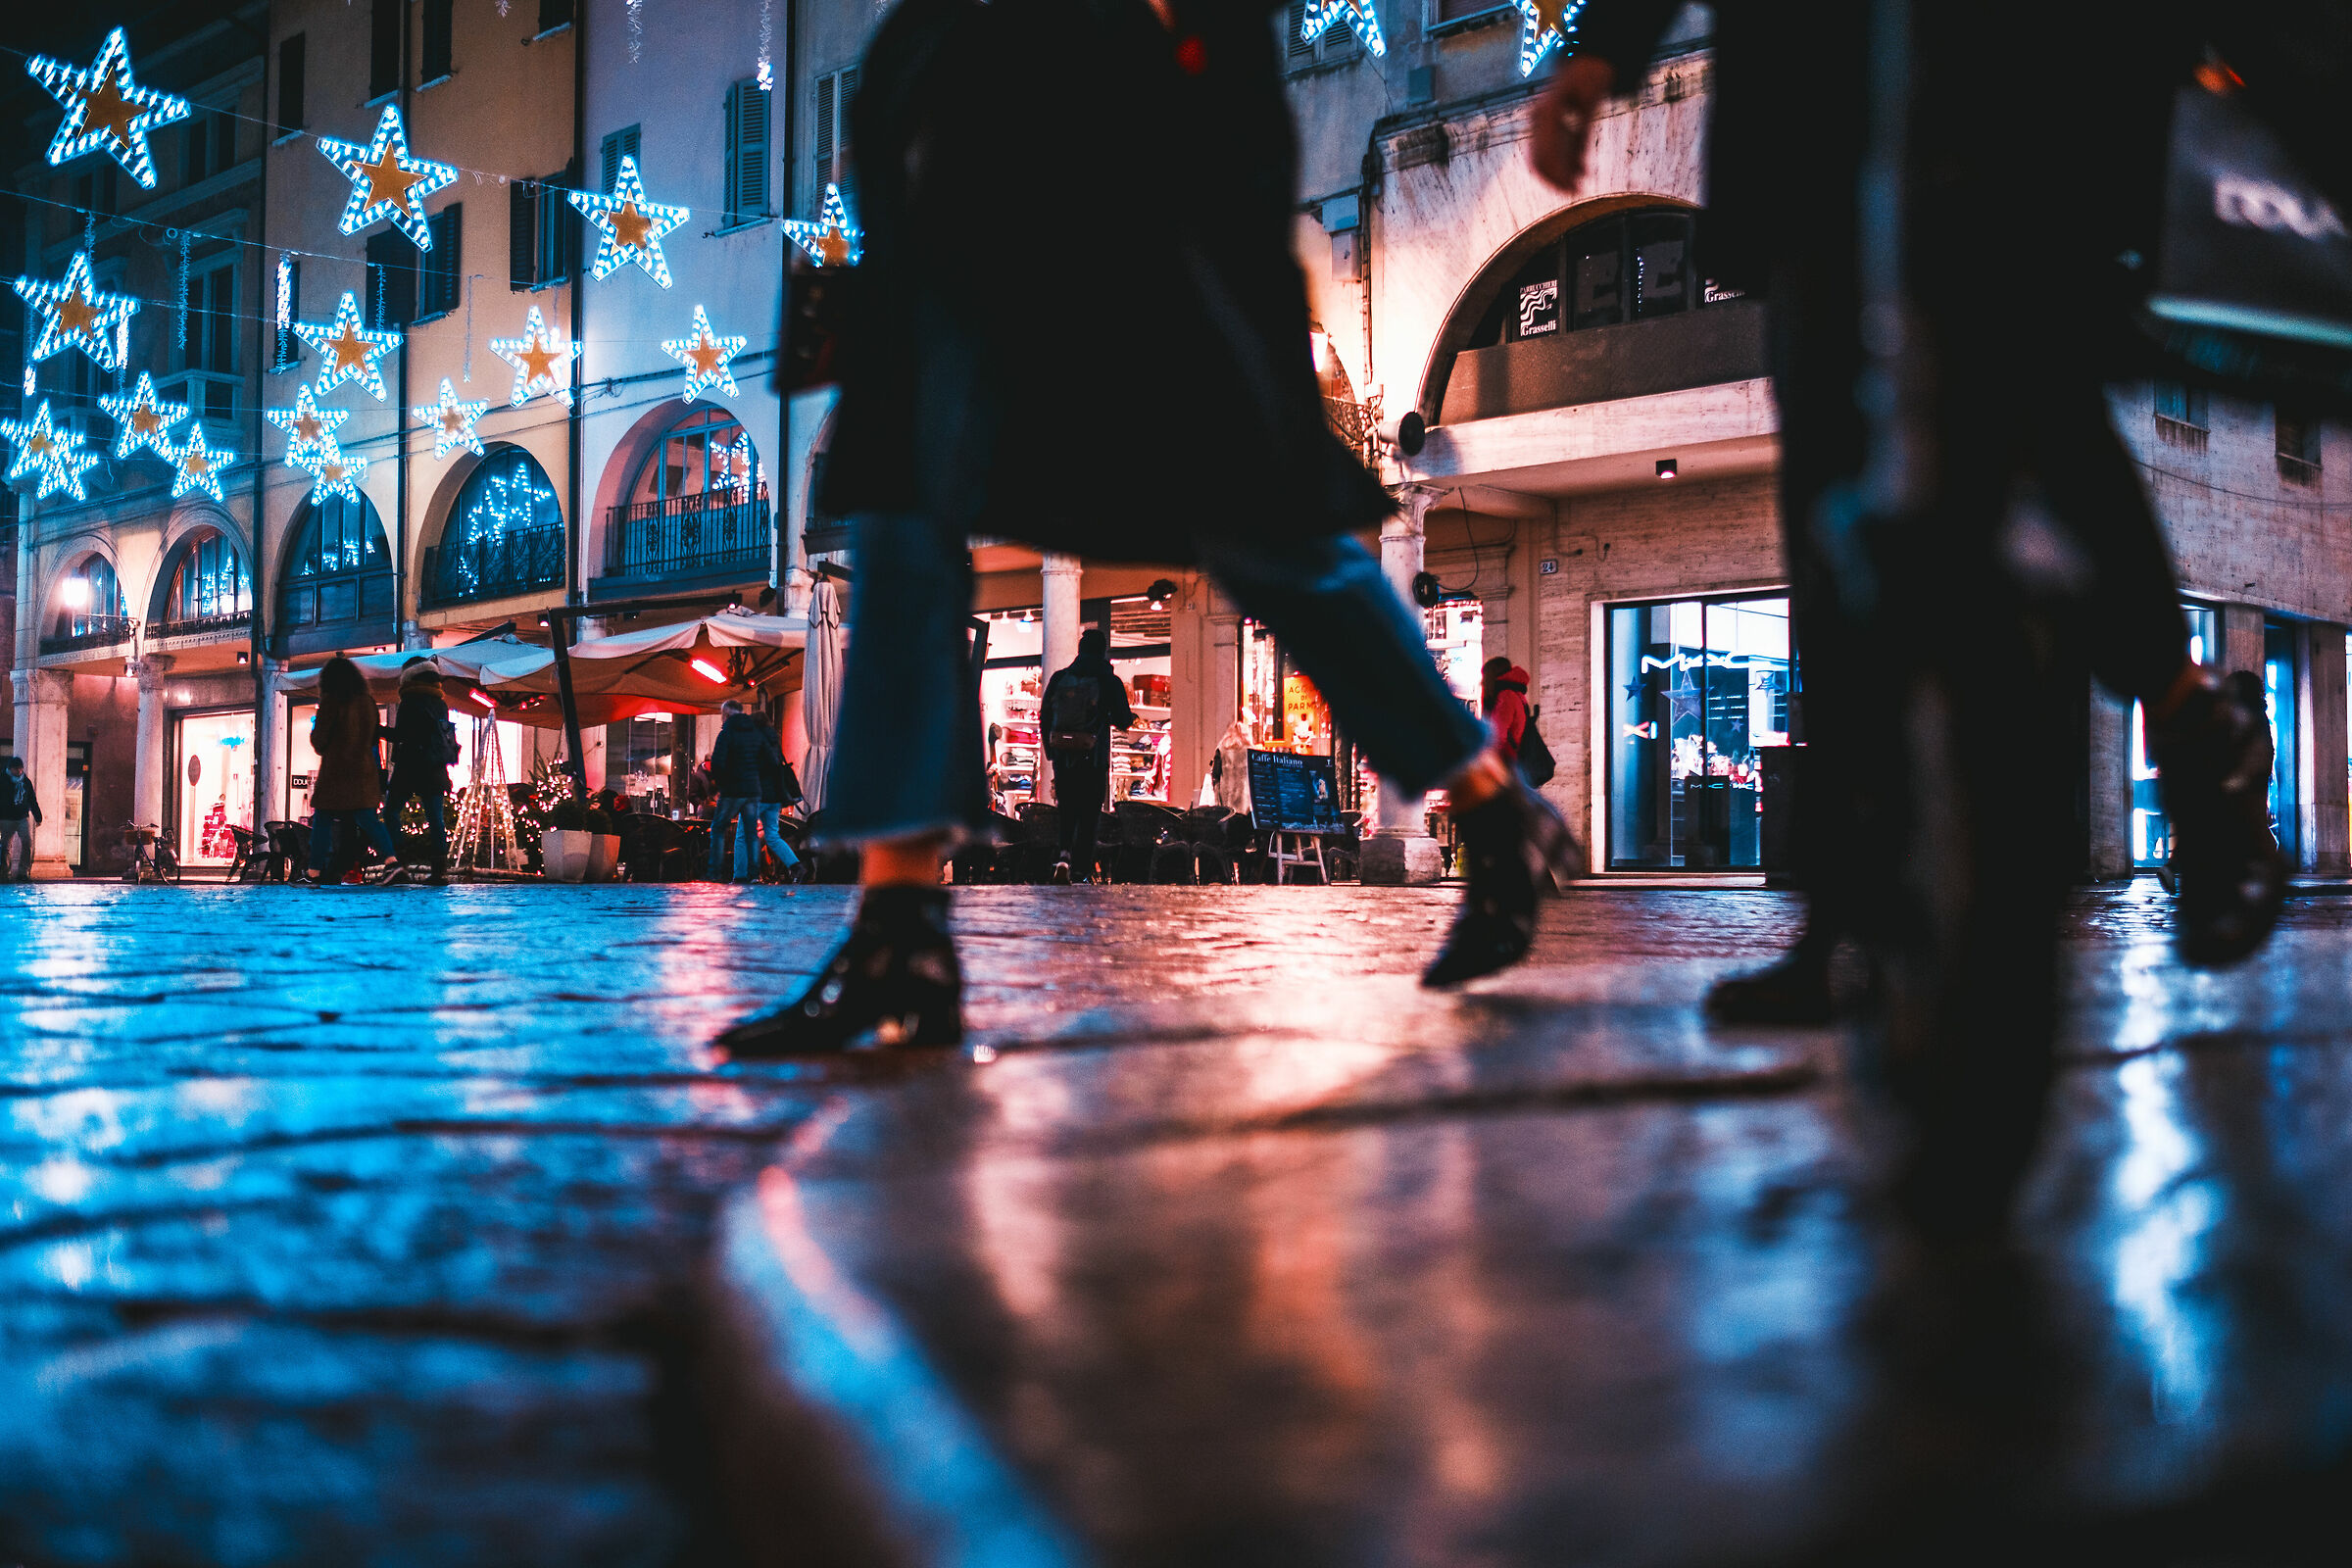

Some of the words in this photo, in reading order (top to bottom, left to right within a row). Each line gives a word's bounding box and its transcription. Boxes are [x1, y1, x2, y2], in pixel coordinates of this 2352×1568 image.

[1522, 319, 1556, 336] Grasselli
[1288, 702, 1316, 711] PARM
[1273, 755, 1303, 765] Italiano
